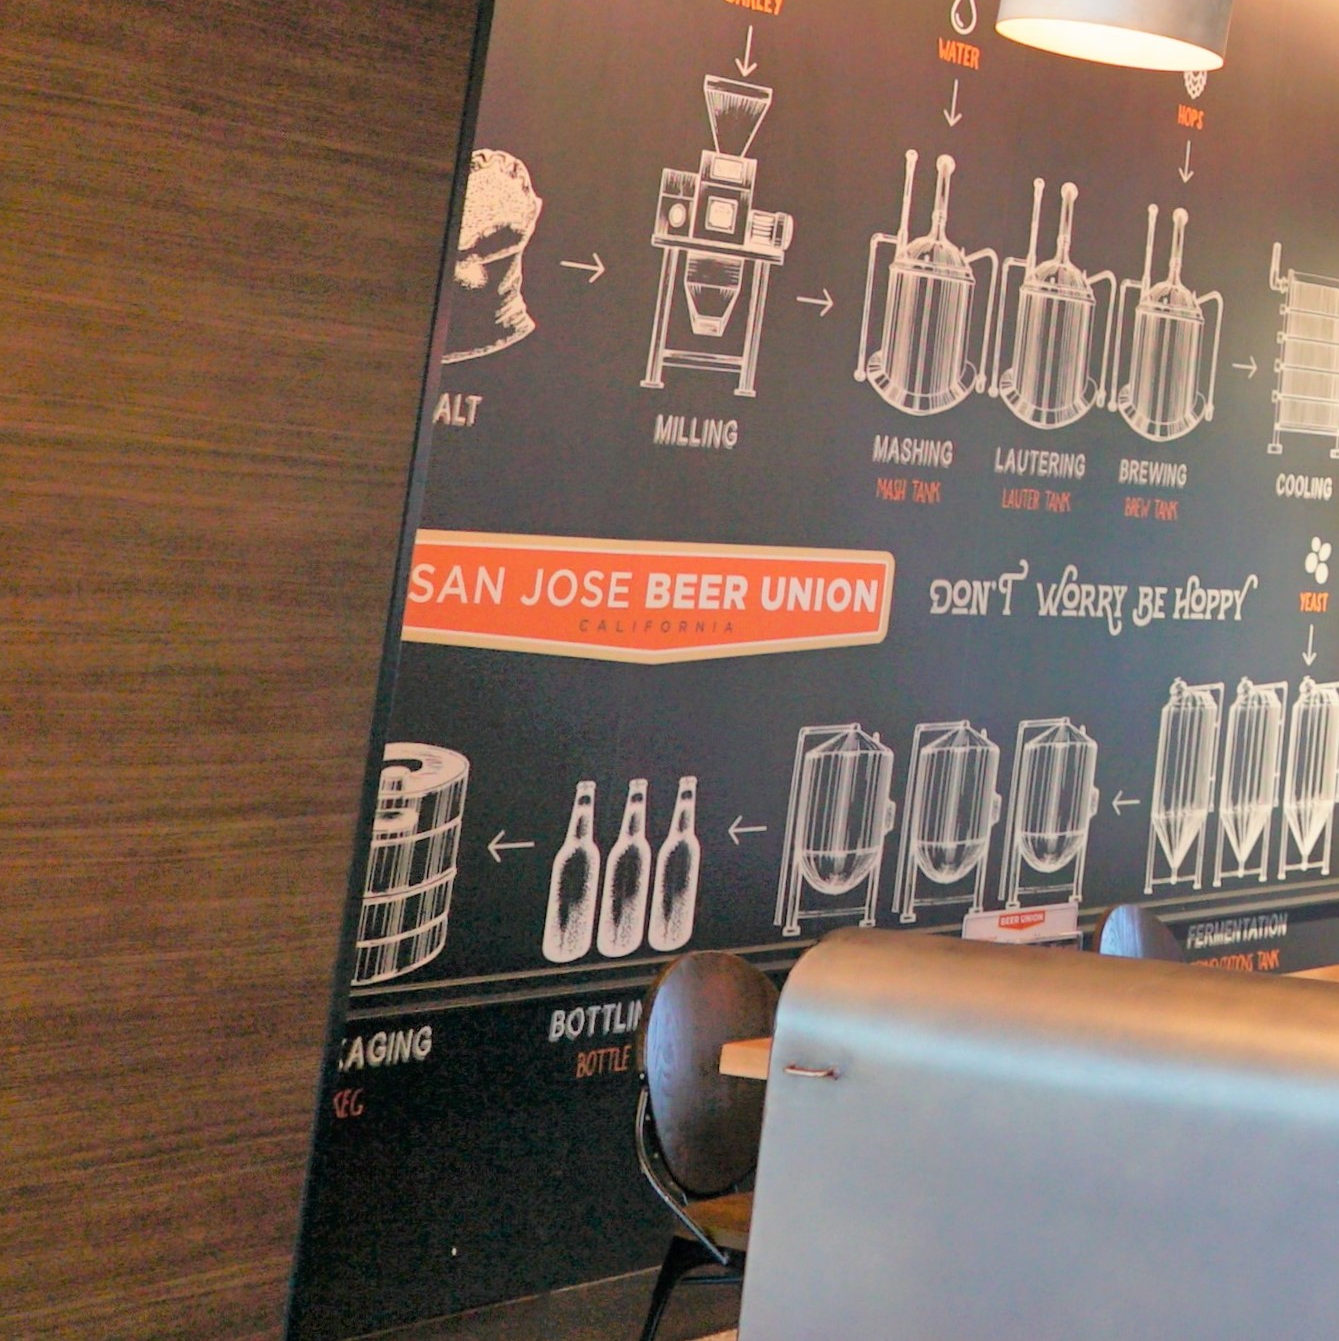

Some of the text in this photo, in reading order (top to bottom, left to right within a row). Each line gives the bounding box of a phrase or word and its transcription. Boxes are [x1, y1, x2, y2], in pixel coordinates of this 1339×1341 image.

[938, 36, 981, 70] WATER
[1177, 104, 1205, 131] HOPS
[653, 414, 739, 449] MILLING
[872, 435, 954, 468] MASHING
[994, 447, 1087, 479] LAUTERING
[1118, 458, 1188, 489] BREWING
[1275, 473, 1333, 501] COOLING
[875, 477, 942, 505] MASH TANK
[1001, 488, 1072, 513] LAUTER TANK
[1124, 496, 1179, 521] BREW TANK
[408, 563, 879, 614] SAN JOSE BEER UNION
[929, 558, 1259, 636] DON'T WORRY BE HOPPY
[1299, 592, 1330, 613] YEAST
[578, 619, 736, 634] CALIFORNIA
[1186, 912, 1288, 950] FERMENTATION
[1257, 948, 1280, 971] TANK
[575, 1043, 632, 1079] BOTTLE
